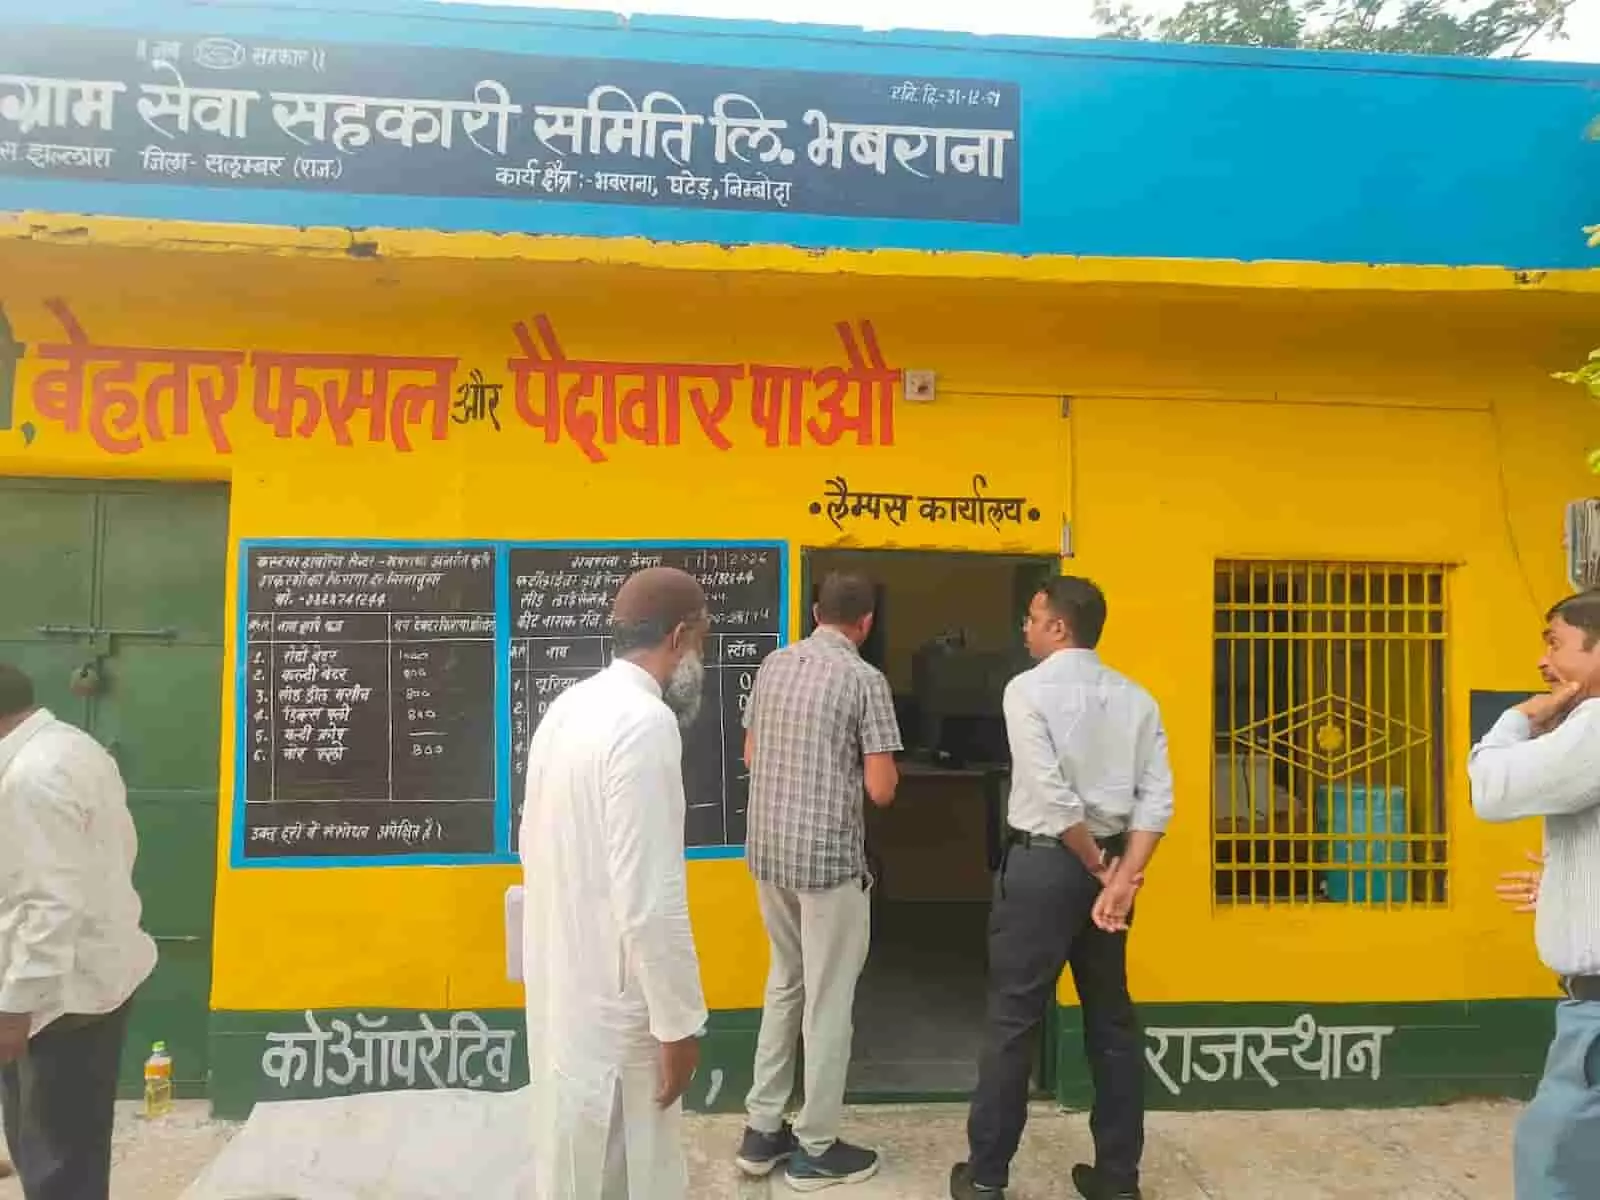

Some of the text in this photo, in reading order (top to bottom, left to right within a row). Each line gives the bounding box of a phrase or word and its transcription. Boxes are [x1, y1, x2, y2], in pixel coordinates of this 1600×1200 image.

[0, 60, 1014, 178] ग्राम सेवा सहकारी समिति लि. भबराना
[495, 158, 540, 187] कार्य
[32, 299, 246, 454] बेहतर
[250, 350, 461, 453] फसल
[451, 369, 504, 431] और
[507, 312, 744, 464] पैदावार
[824, 474, 1026, 528] लैम्पस कार्यालय
[262, 1010, 515, 1088] कोऑपरेटिव
[1145, 1013, 1396, 1094] राजस्थान
